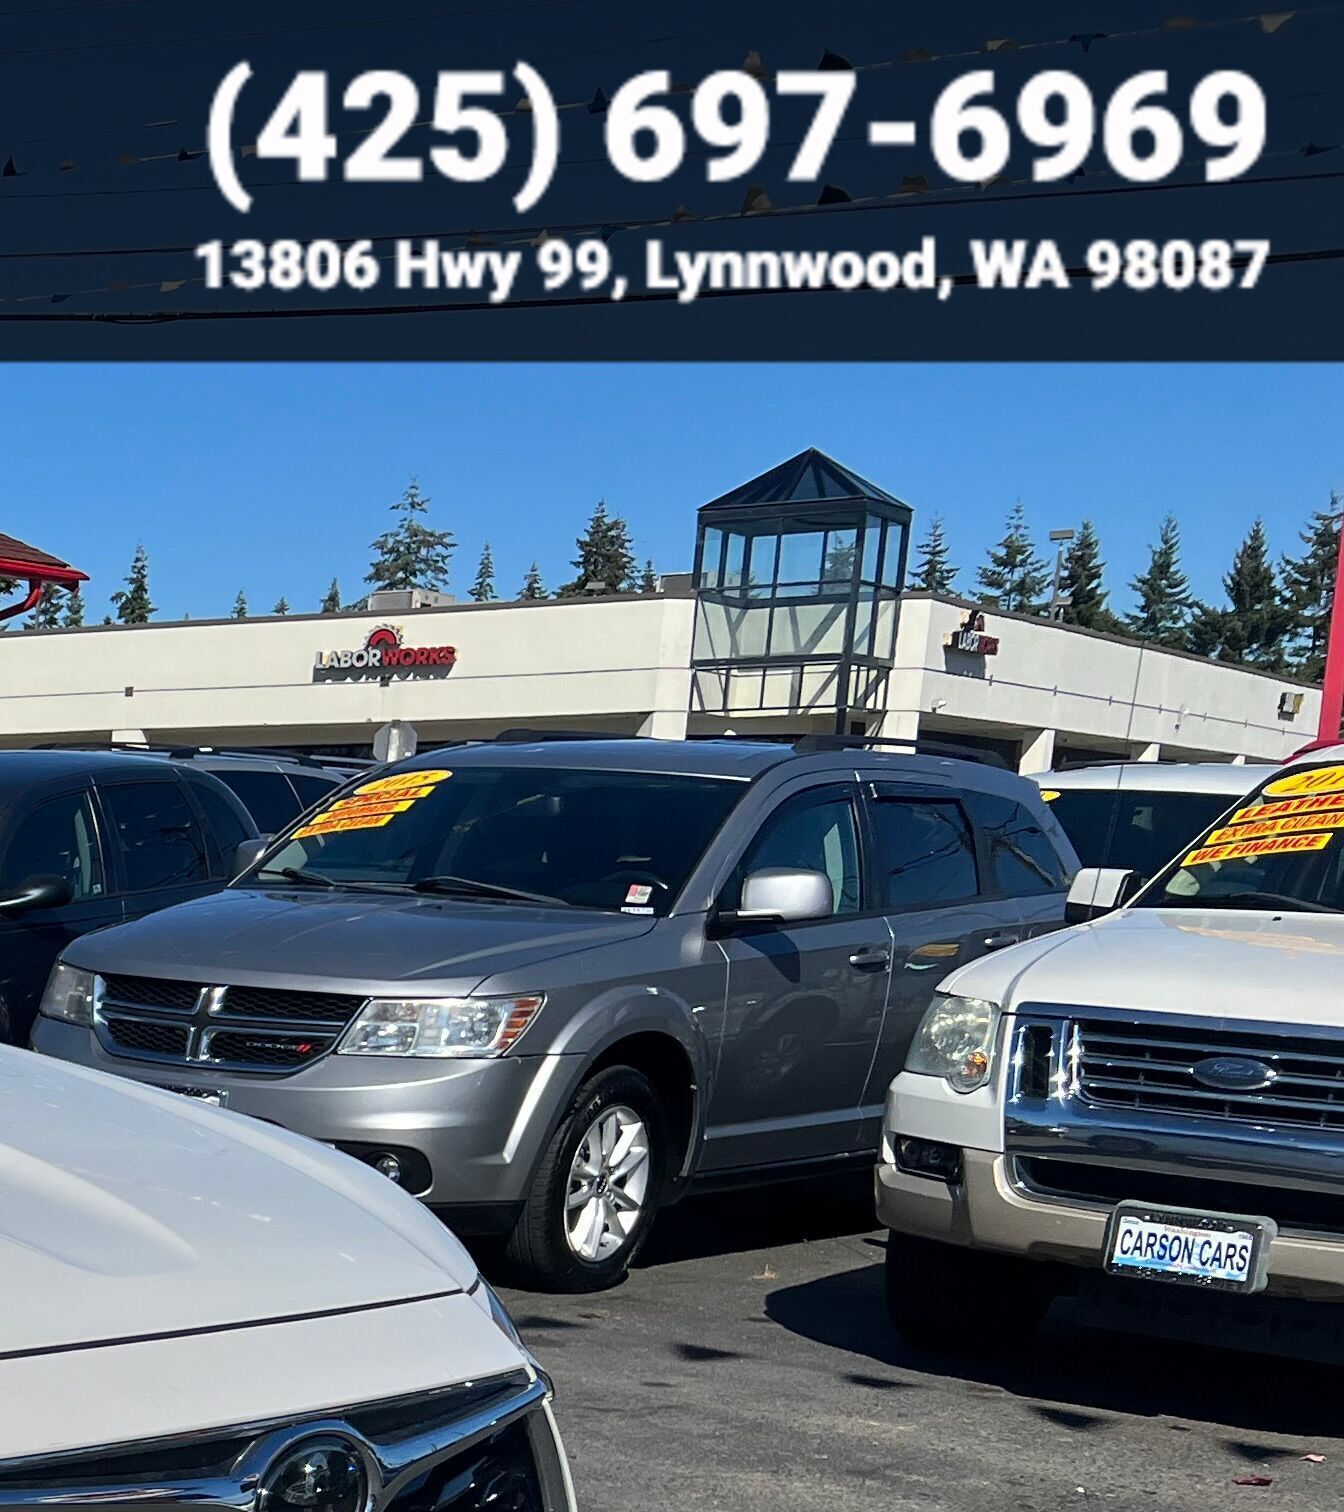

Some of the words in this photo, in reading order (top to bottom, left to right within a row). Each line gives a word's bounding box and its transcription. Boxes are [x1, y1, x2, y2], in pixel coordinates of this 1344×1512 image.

[1214, 822, 1277, 842] EXTRA
[1281, 814, 1344, 833] CLEAN
[1191, 846, 1223, 863] WE
[1226, 835, 1321, 856] FINANCE
[1120, 1228, 1195, 1264] CARSON
[1199, 1239, 1249, 1272] CARS
